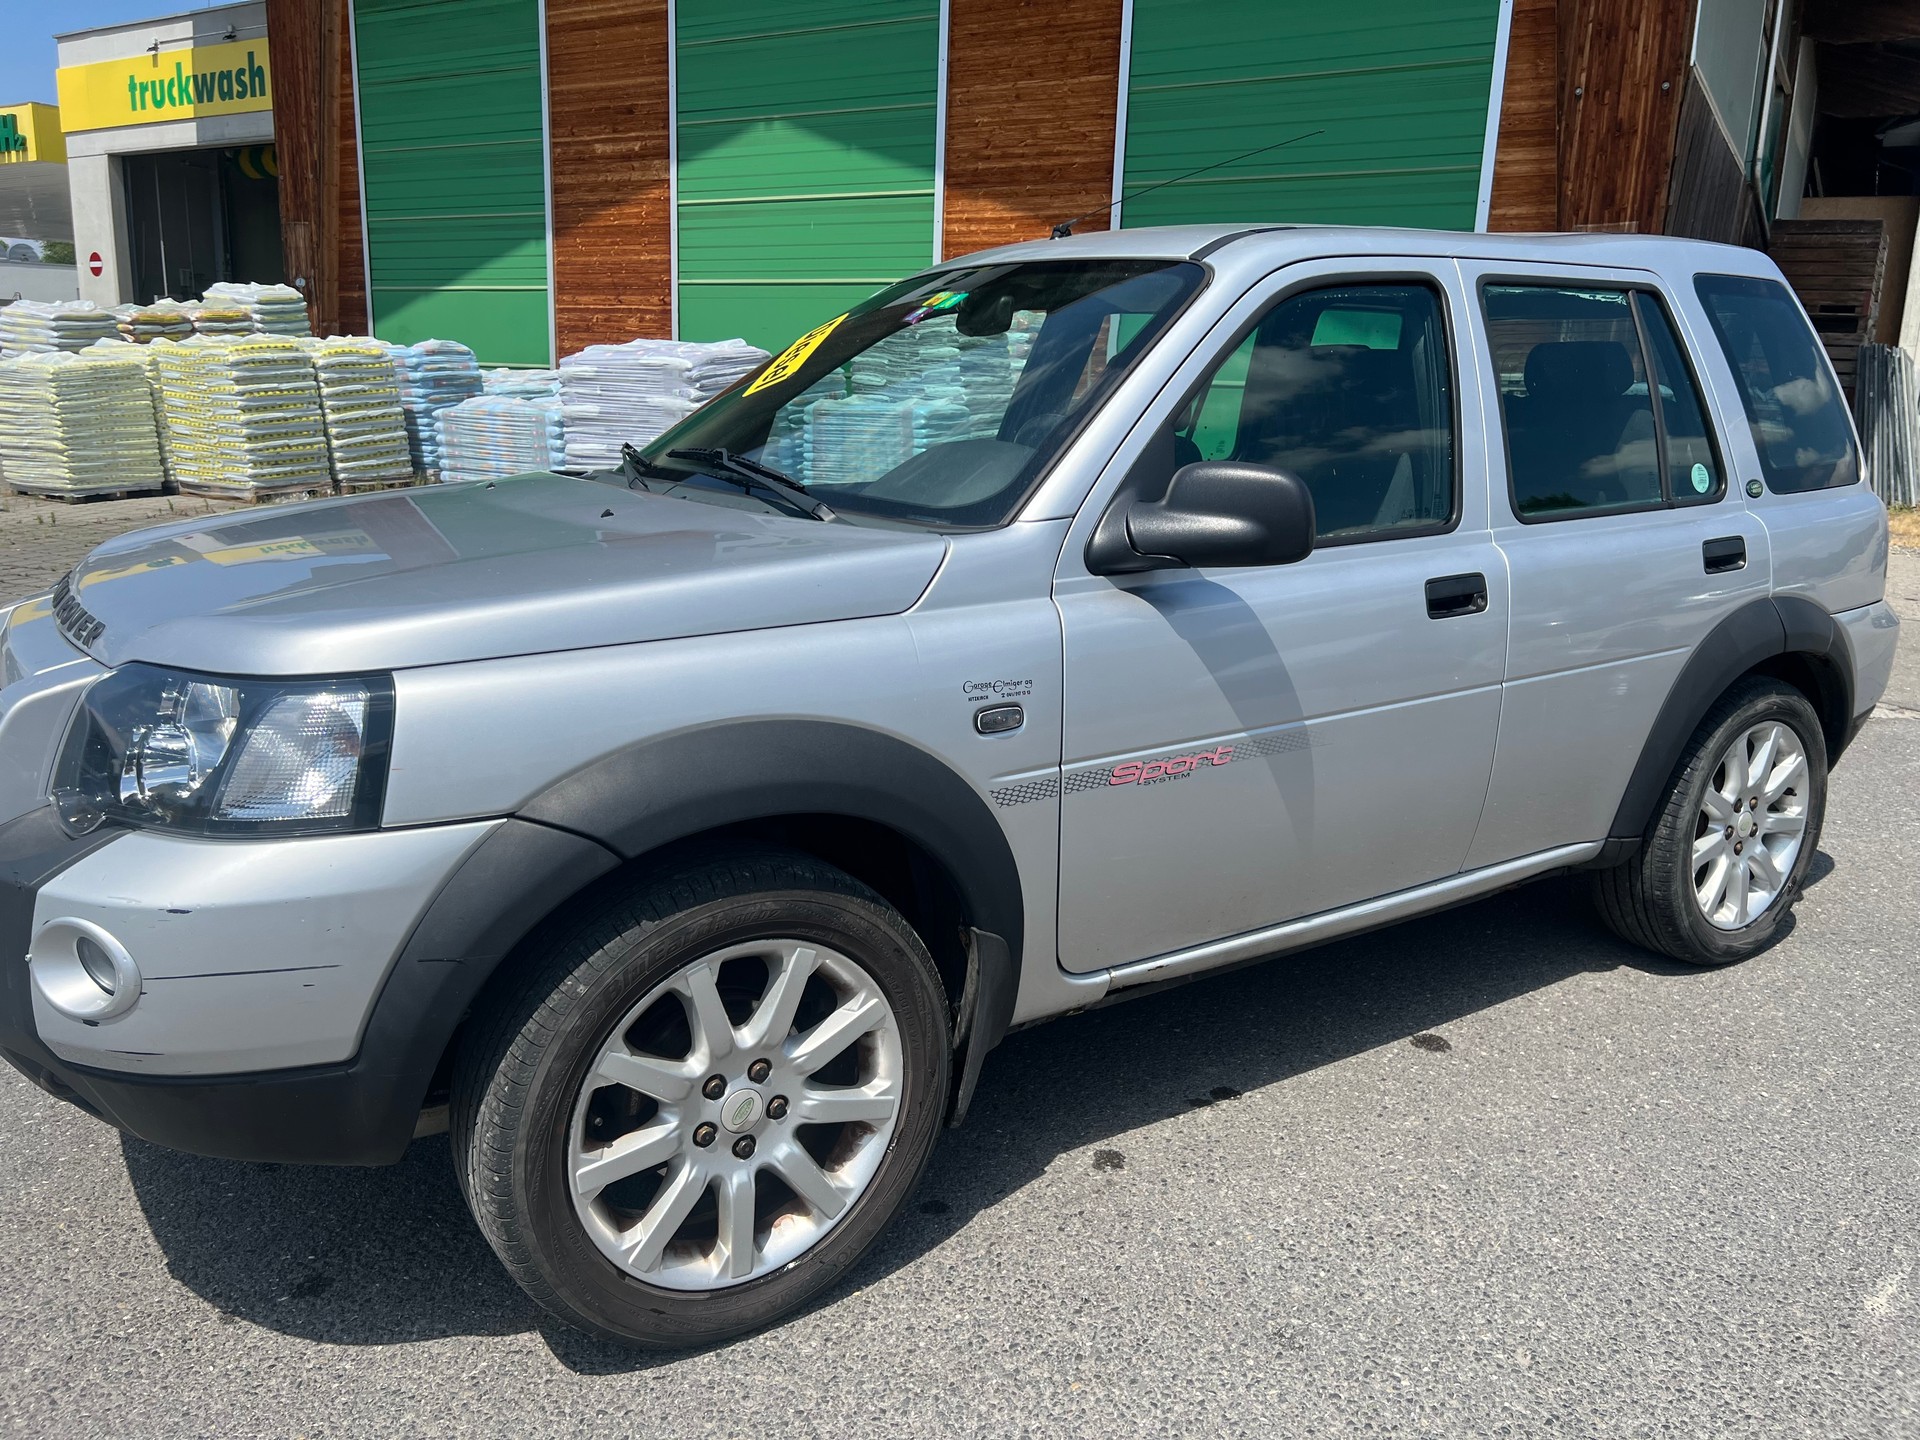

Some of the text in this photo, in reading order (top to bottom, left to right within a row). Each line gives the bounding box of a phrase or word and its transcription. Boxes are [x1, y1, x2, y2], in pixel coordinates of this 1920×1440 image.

[129, 51, 266, 111] truckwash
[962, 680, 992, 694] Garage
[992, 679, 1023, 694] Elmiger
[1109, 746, 1232, 786] Sport
[1144, 772, 1191, 786] SYSTEM
